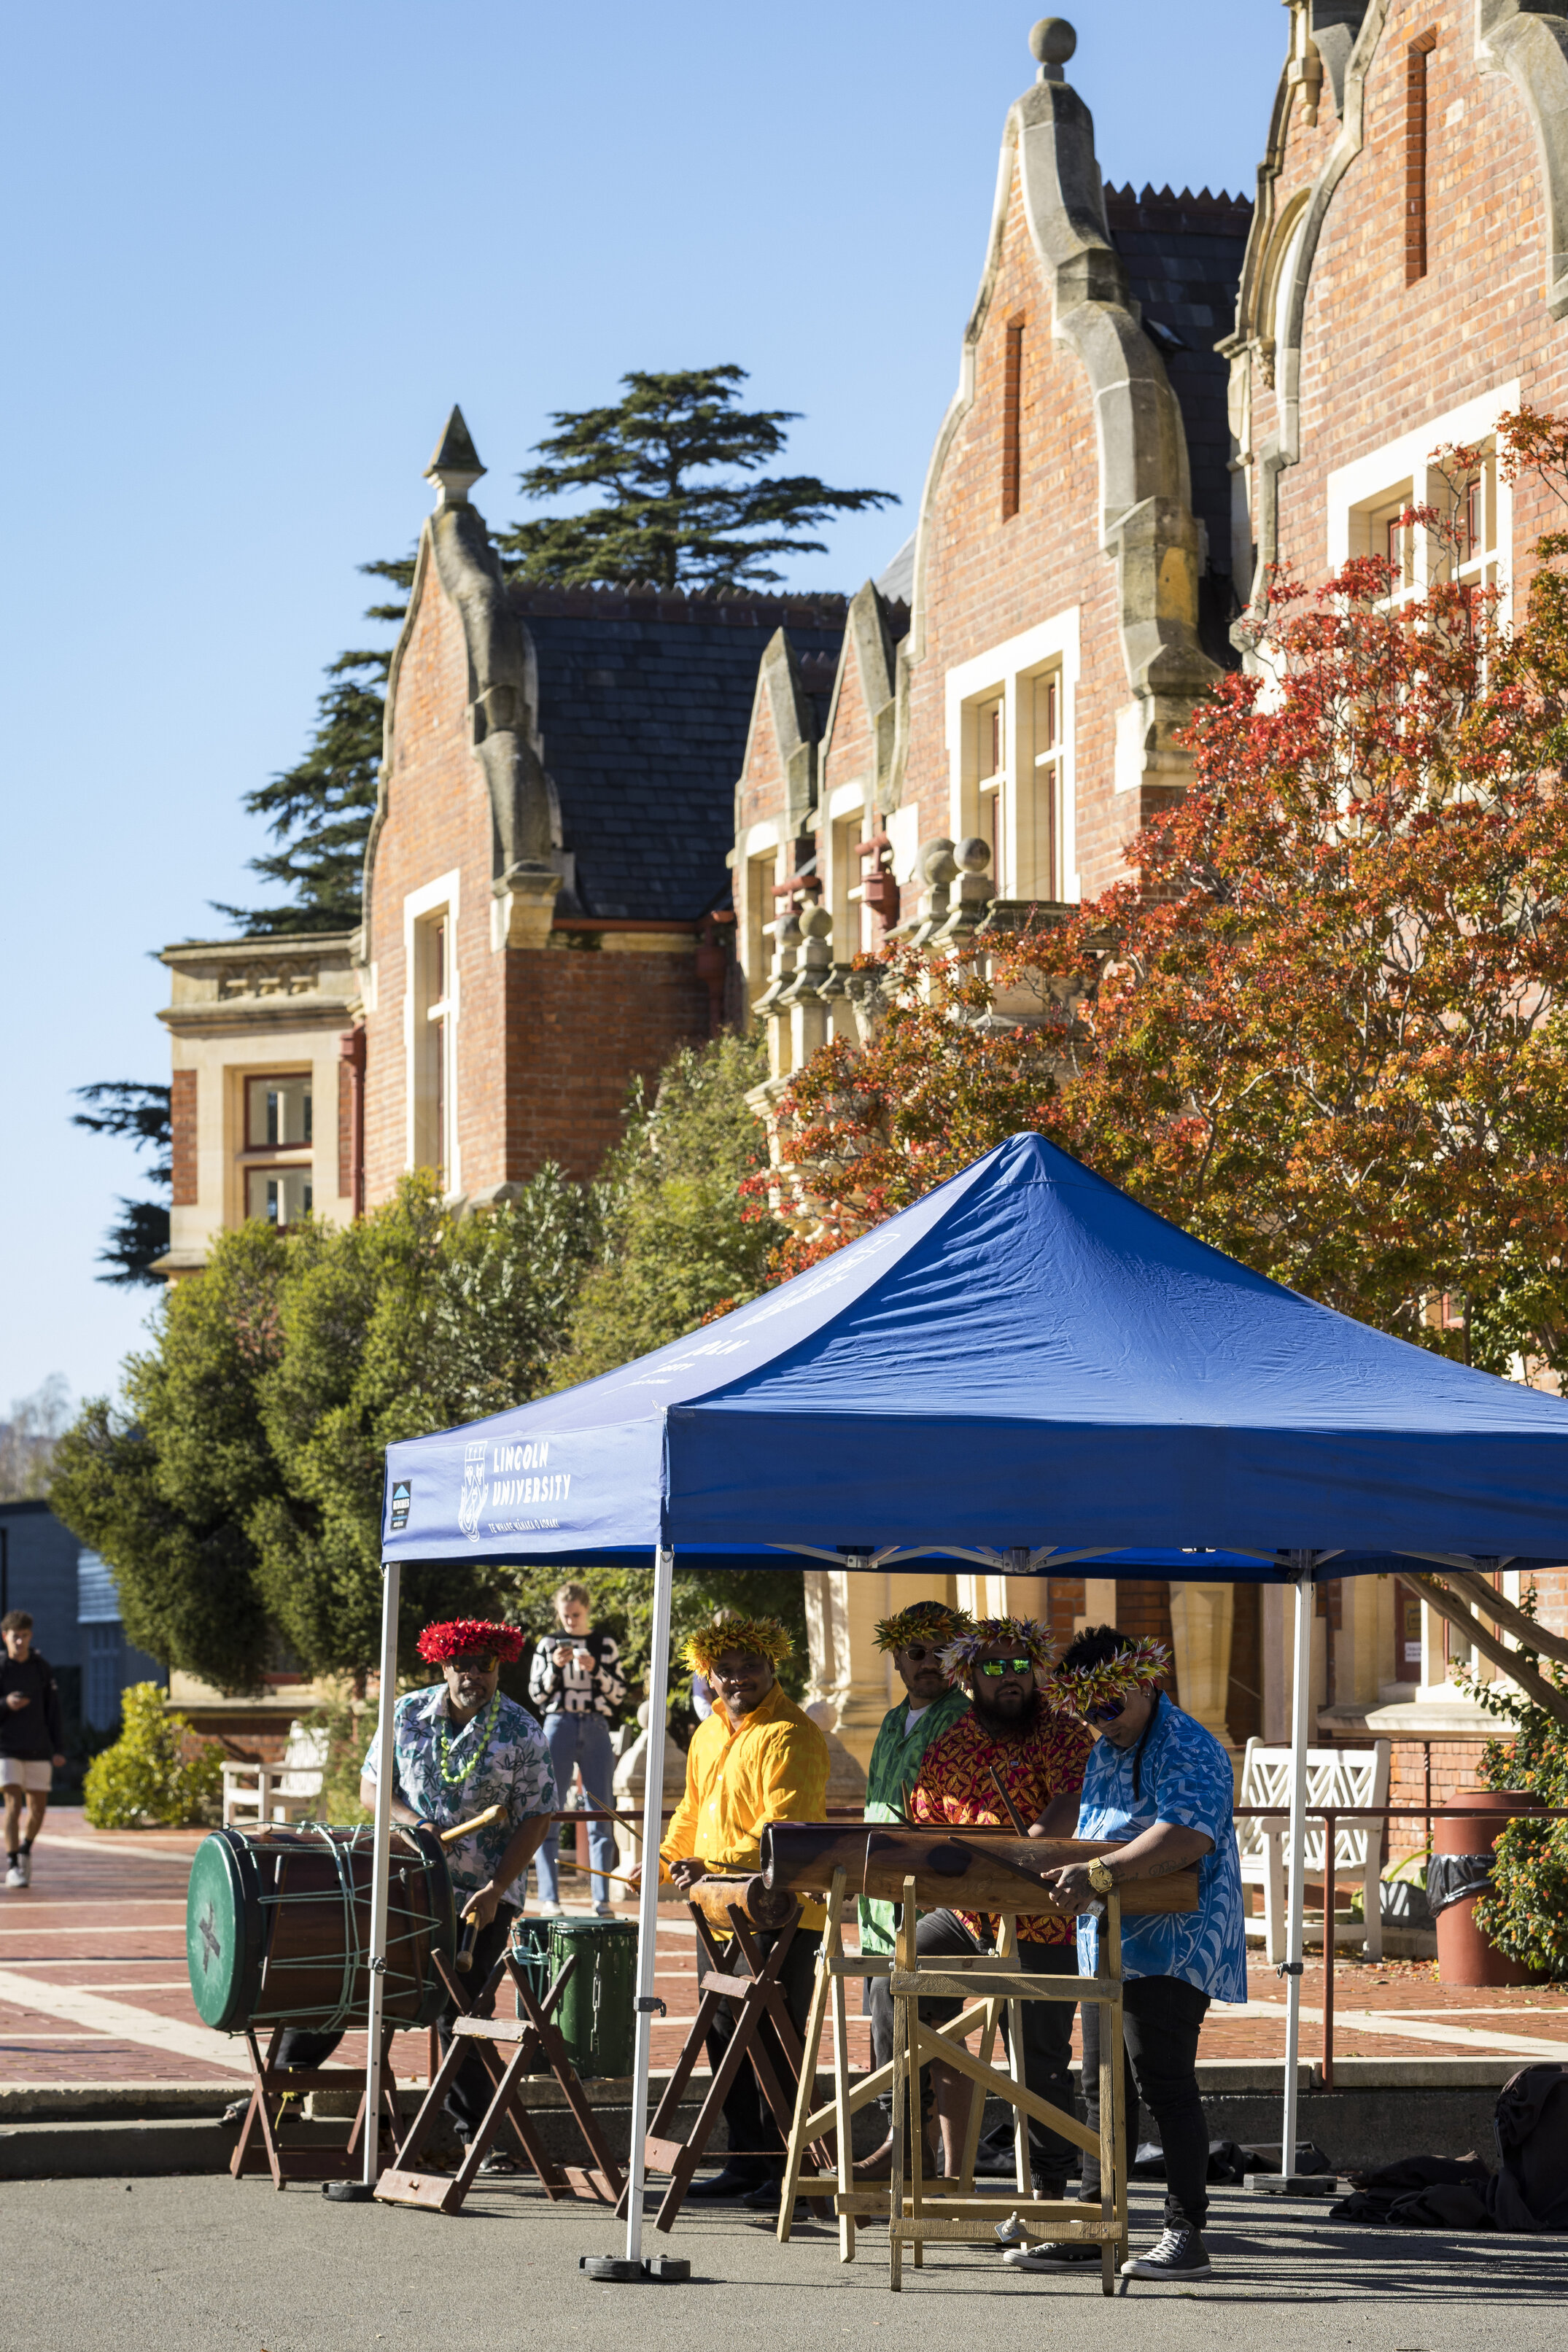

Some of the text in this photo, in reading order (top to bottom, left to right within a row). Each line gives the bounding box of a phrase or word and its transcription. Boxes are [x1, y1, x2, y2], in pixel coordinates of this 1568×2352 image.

[494, 1441, 549, 1472] LINCOLN
[492, 1474, 571, 1507] UNIVERSITY
[488, 1523, 497, 1534] TE
